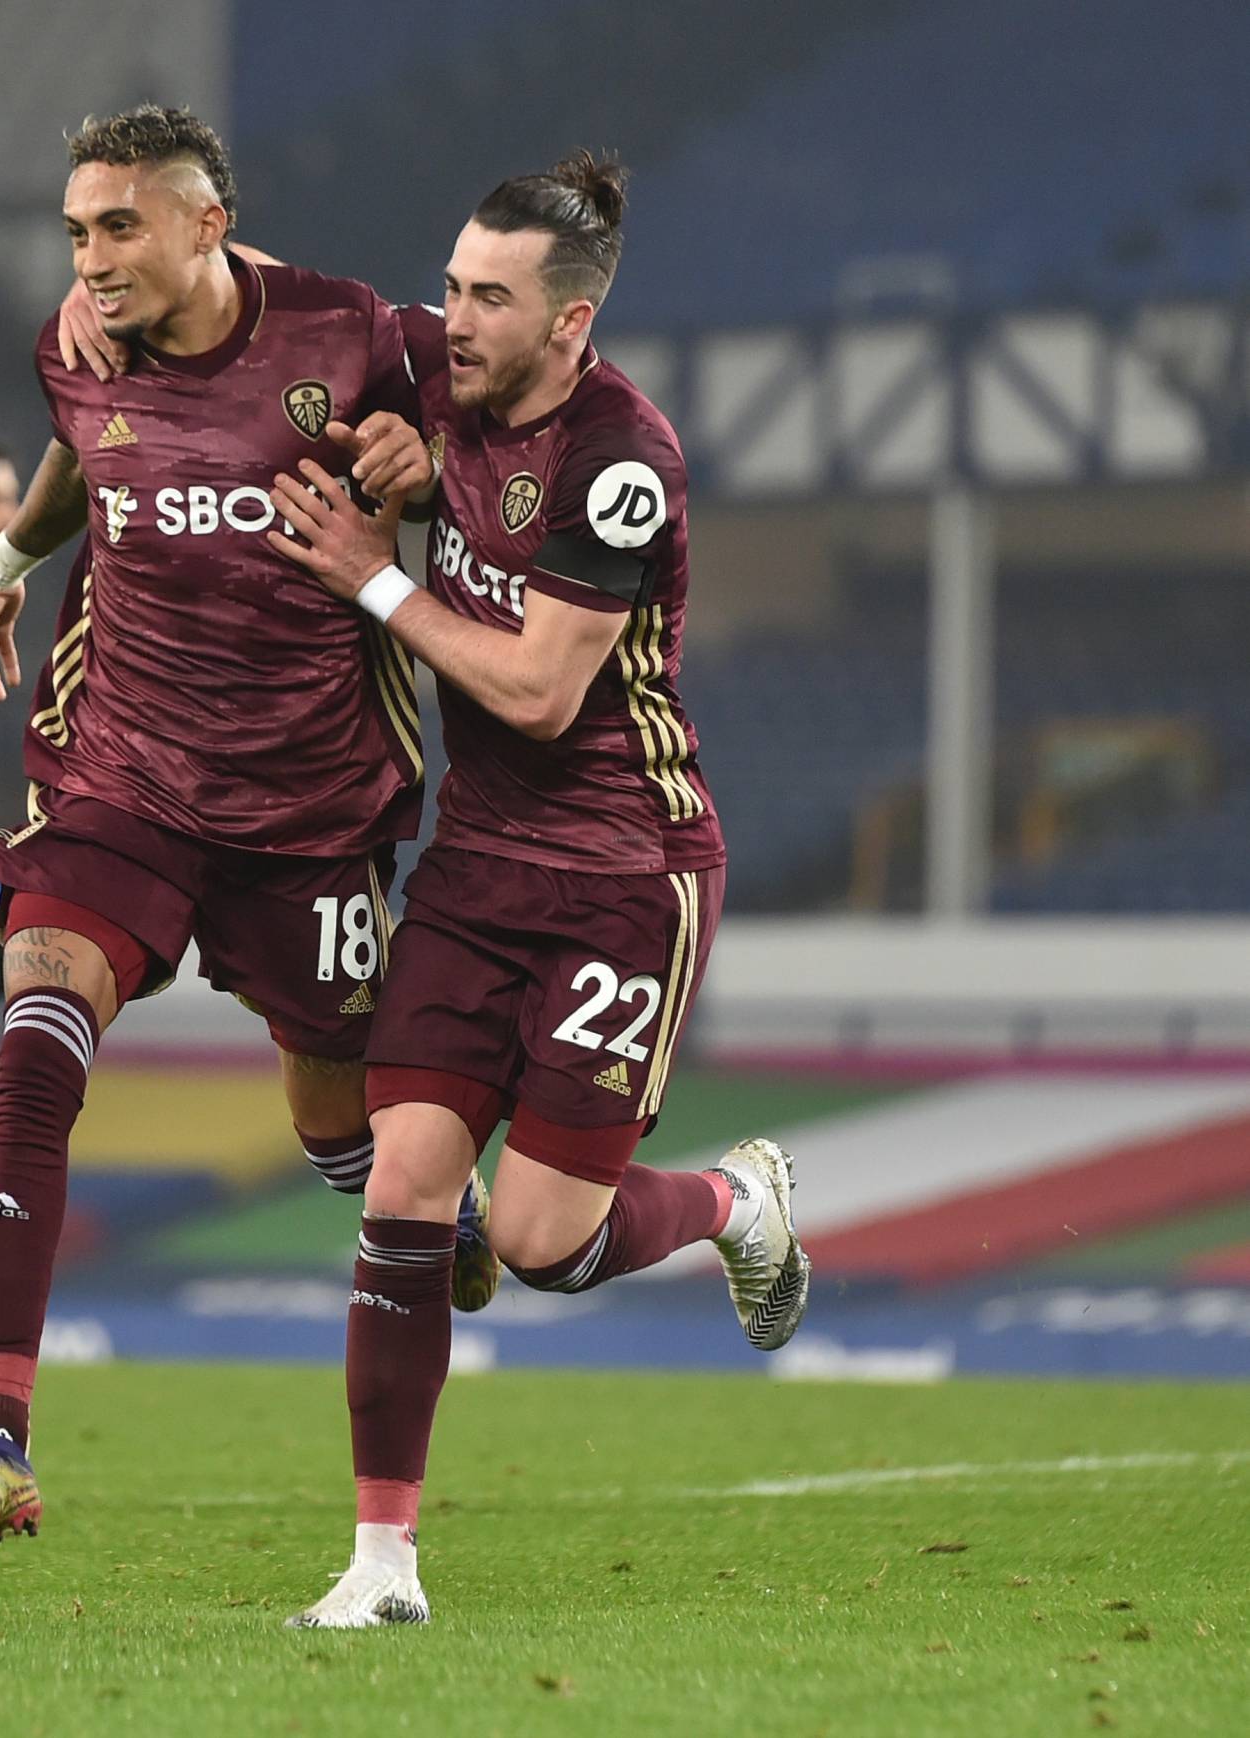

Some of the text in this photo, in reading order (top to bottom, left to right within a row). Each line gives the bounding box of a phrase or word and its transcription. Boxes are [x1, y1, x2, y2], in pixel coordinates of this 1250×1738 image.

[596, 482, 657, 528] JD
[312, 893, 378, 981] 18
[551, 961, 662, 1062] 22
[593, 1074, 632, 1097] adidas
